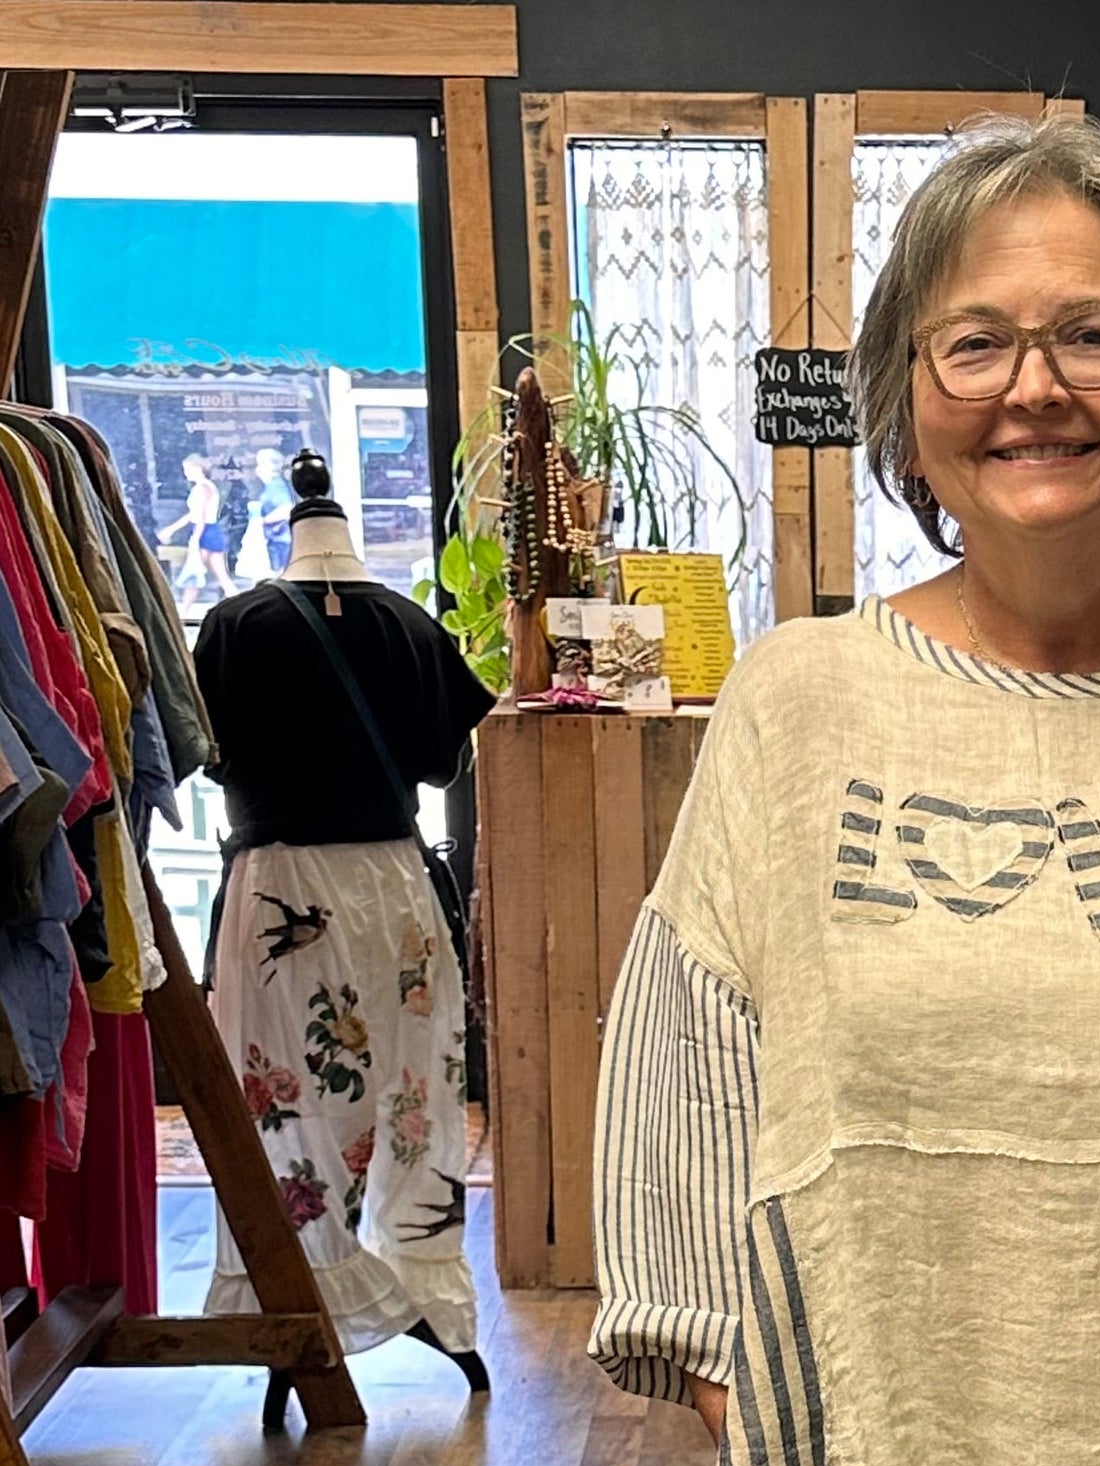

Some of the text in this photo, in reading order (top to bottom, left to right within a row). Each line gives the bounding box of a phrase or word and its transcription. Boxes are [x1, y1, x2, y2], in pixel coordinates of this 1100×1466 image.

[760, 352, 844, 387] No Retu
[756, 385, 842, 419] Exchanges
[759, 415, 779, 440] 14
[786, 416, 825, 443] Days
